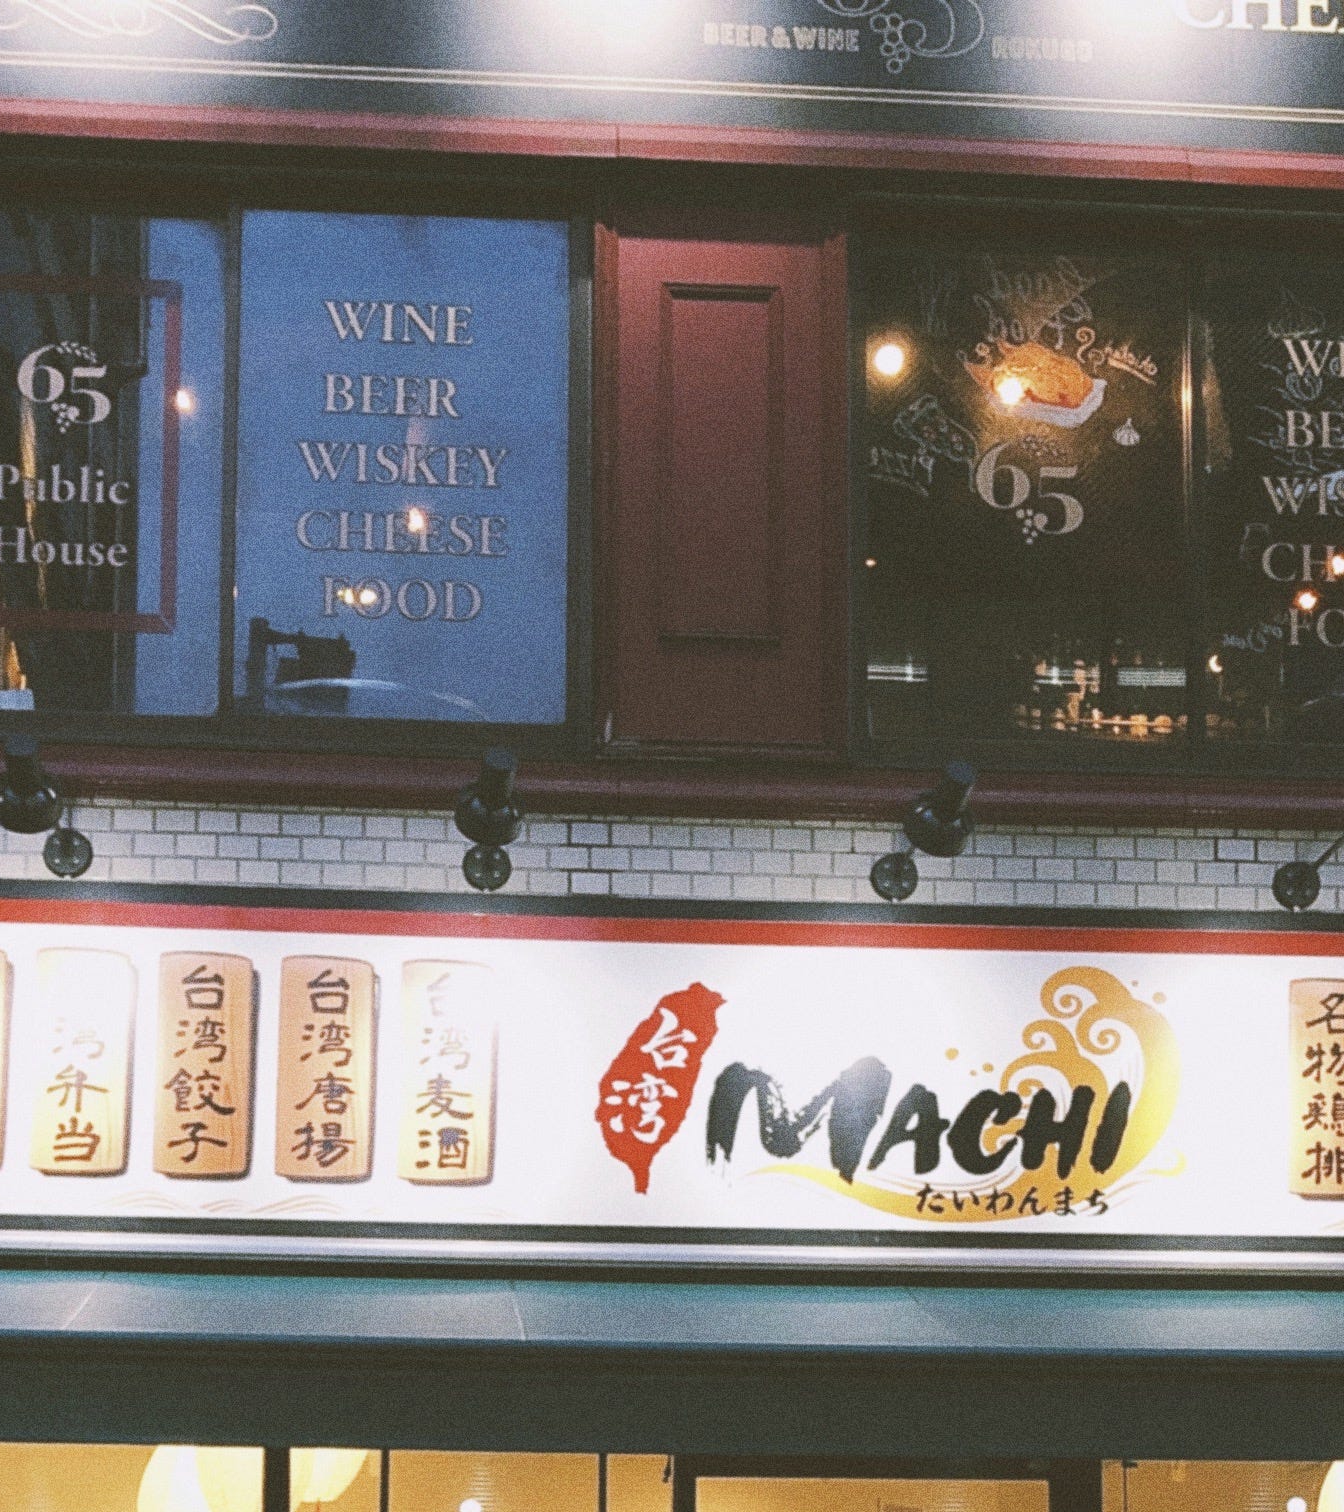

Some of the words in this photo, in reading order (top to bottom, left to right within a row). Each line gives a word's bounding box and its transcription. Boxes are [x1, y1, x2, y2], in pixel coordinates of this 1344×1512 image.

[324, 301, 474, 345] WINE
[17, 344, 112, 424] 65
[324, 374, 459, 418] BEER
[298, 441, 511, 488] WISKEY
[975, 441, 1085, 535] 65
[297, 510, 508, 557] CHEESE
[321, 575, 483, 622] FOOD
[163, 963, 235, 1163] 台湾餃子
[292, 969, 356, 1168] 台湾唐揚
[605, 1006, 698, 1144] 台湾
[704, 1055, 1132, 1187] MACHI
[915, 1183, 1110, 1217] たいわんまち
